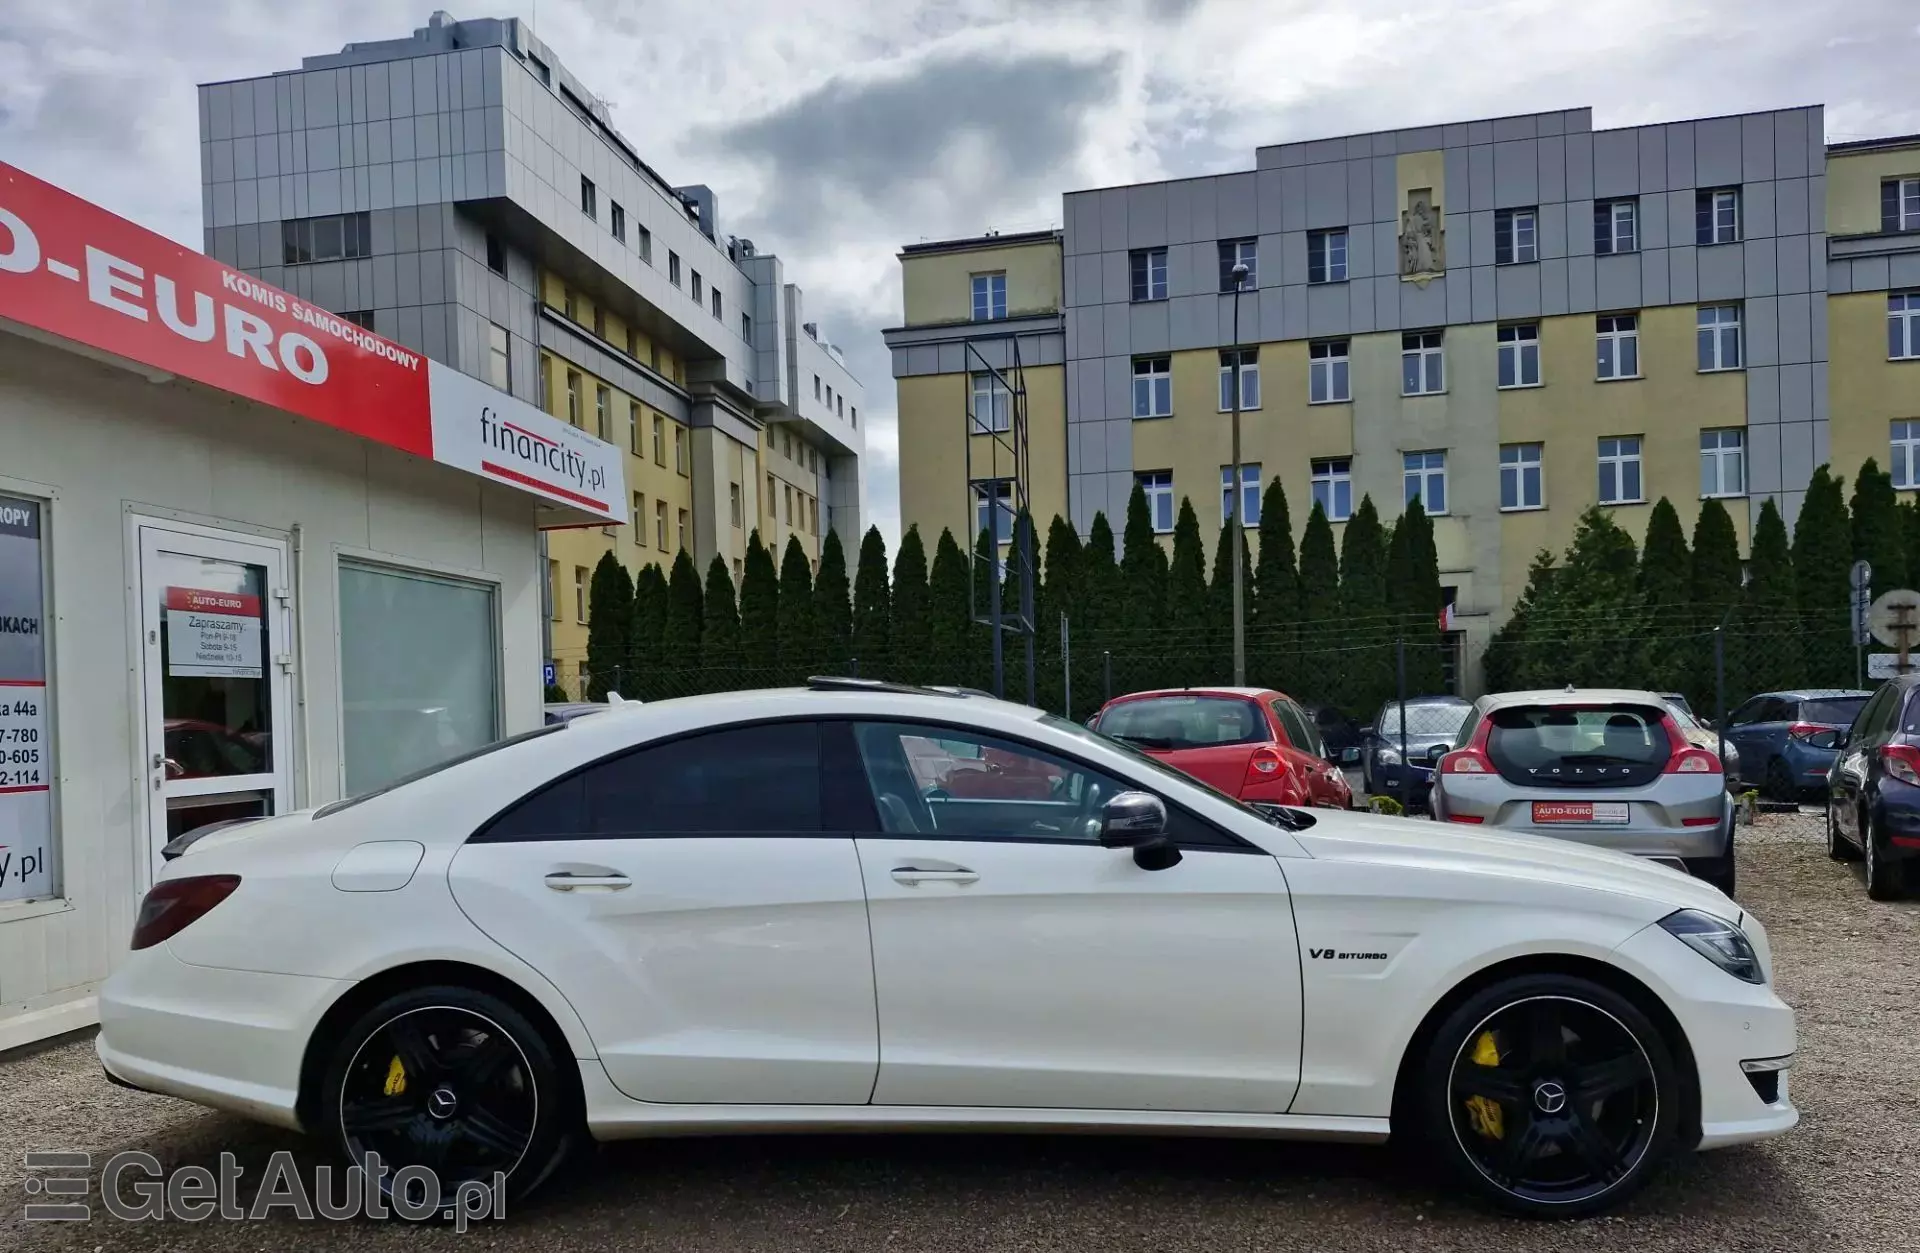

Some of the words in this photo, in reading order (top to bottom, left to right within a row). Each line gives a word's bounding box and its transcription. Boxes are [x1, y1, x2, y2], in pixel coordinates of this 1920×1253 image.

[222, 269, 287, 314] KOMIS
[292, 301, 419, 372] SAMOCHODOWY
[480, 406, 606, 492] financity.pl
[192, 596, 242, 609] AUTO-EURO
[0, 615, 38, 635] KACH
[189, 615, 247, 633] Zapraszamy:
[14, 700, 37, 717] 44a
[0, 769, 40, 785] 2-114
[1539, 807, 1592, 815] AUTO-EURO
[1309, 948, 1336, 960] V8
[1338, 952, 1388, 960] BITURBO
